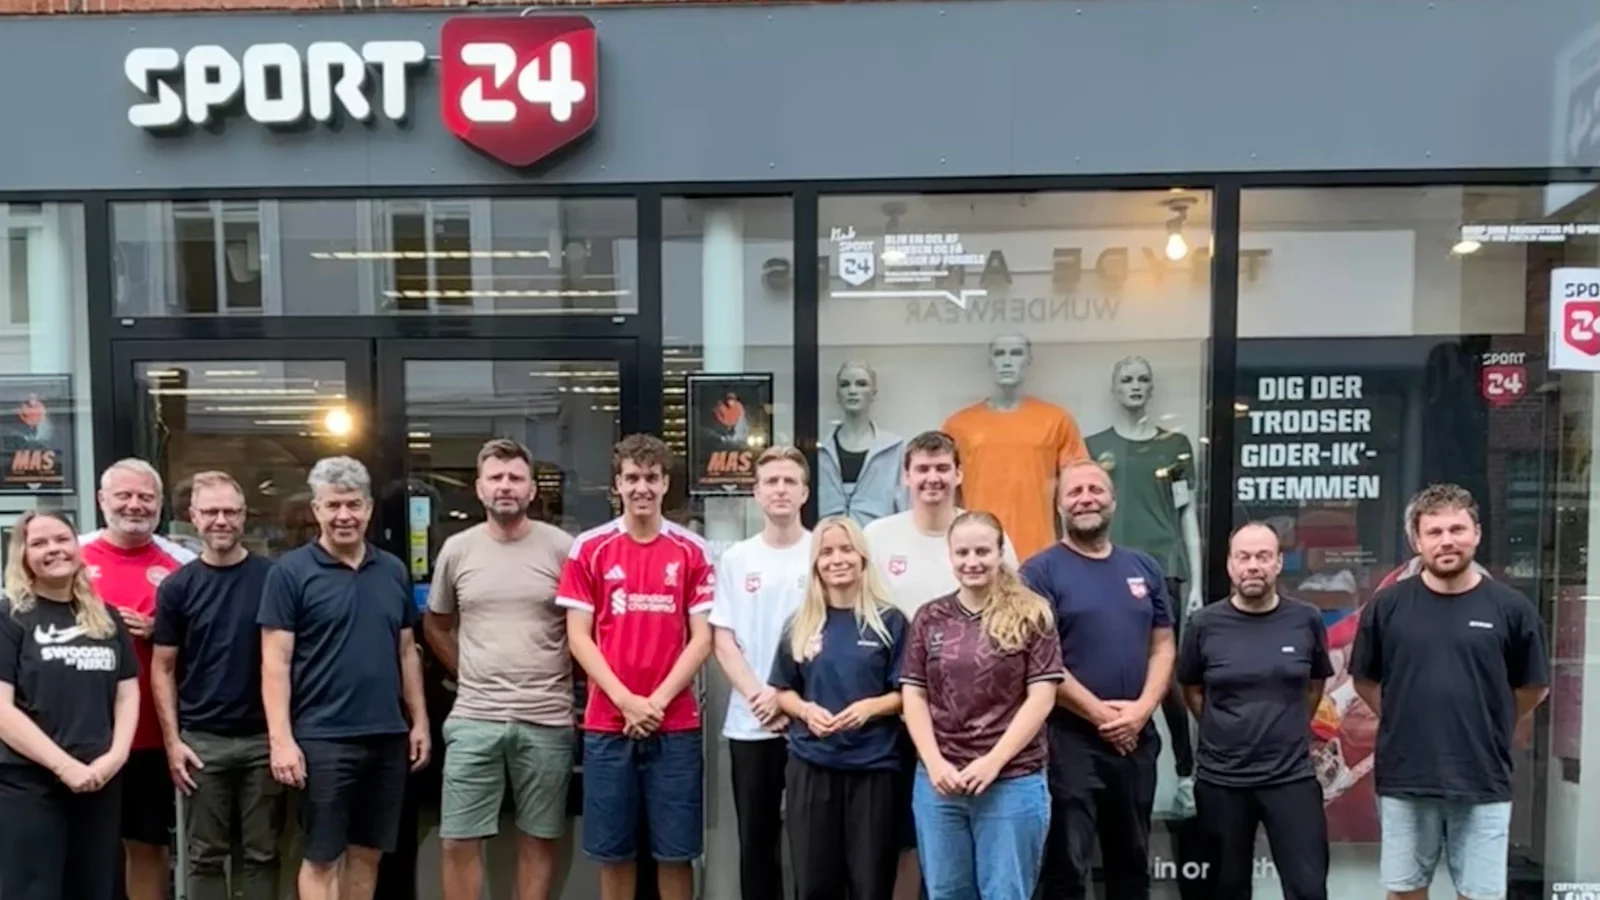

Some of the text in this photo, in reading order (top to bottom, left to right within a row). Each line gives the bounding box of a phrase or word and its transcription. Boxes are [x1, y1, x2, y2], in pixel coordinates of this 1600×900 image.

[124, 40, 586, 127] SPORT 24
[844, 258, 870, 275] 24
[1482, 352, 1526, 365] SPORT
[1258, 375, 1363, 401] DIG DER
[1487, 373, 1523, 394] 24
[1248, 408, 1372, 434] TRODSER
[12, 449, 56, 471] MAS
[707, 450, 753, 472] MAS
[1237, 475, 1380, 500] STEMMEN
[1154, 857, 1177, 879] in
[1182, 861, 1210, 879] or
